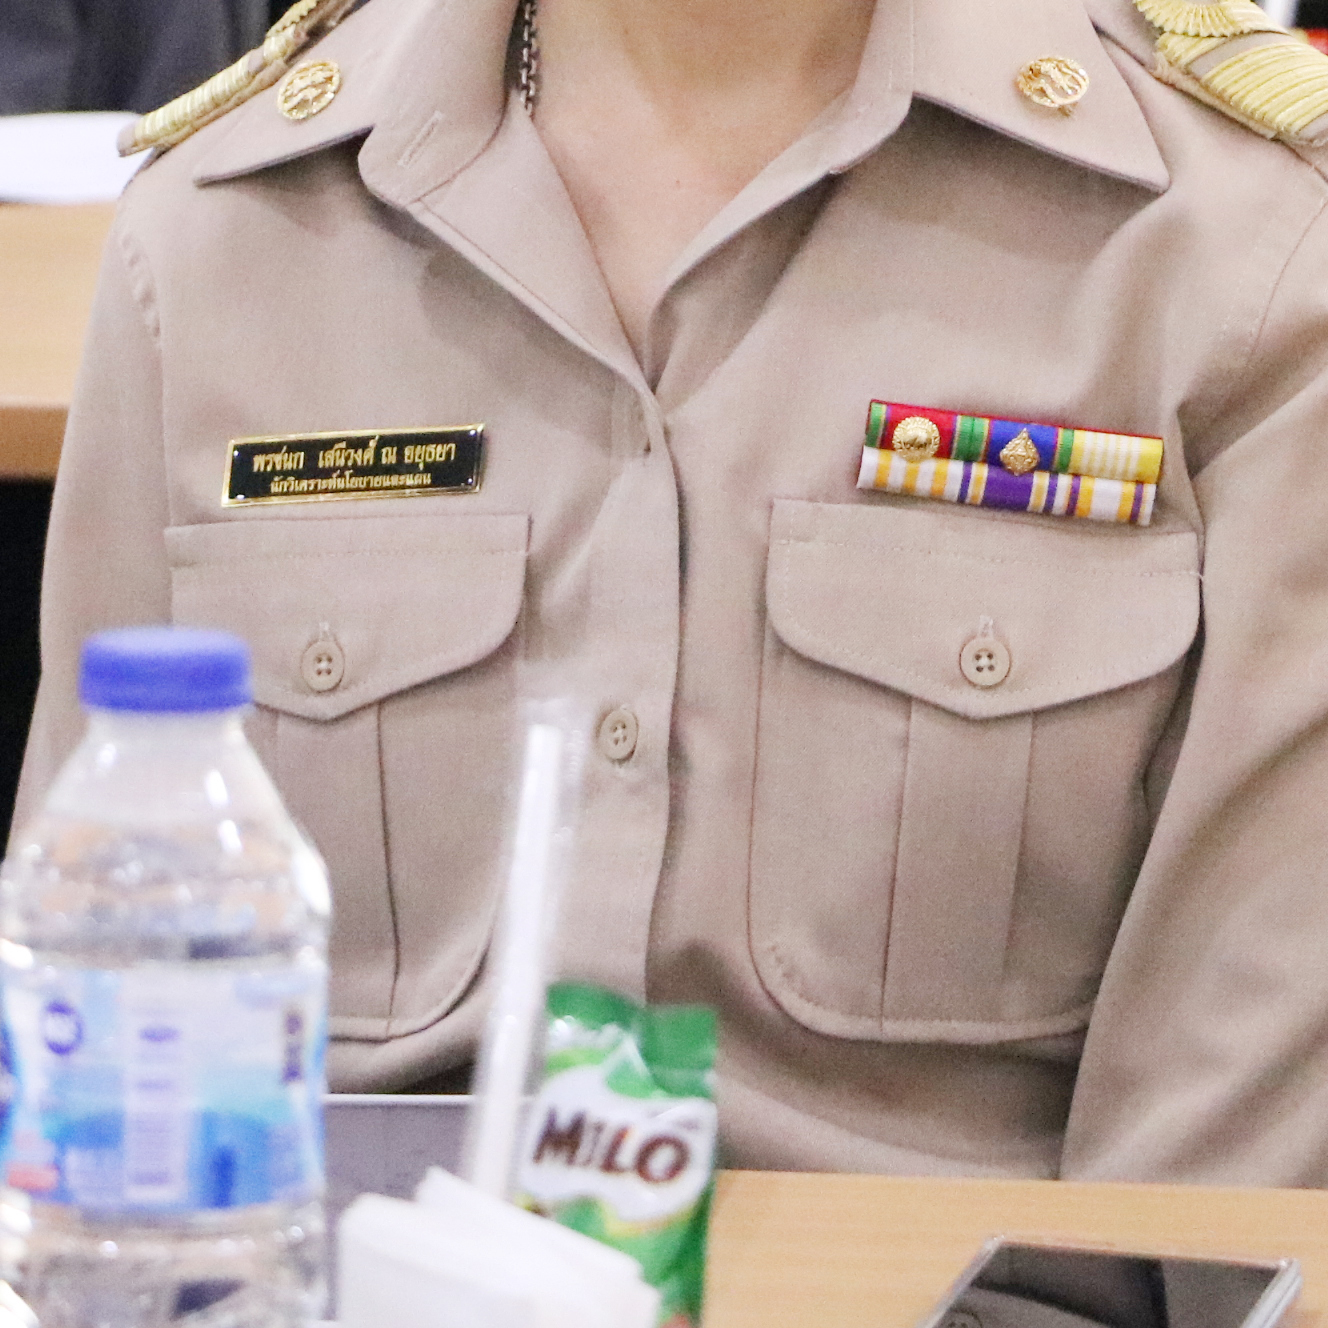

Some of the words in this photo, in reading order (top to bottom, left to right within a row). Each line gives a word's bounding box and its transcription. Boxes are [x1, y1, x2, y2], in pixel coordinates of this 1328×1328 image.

[381, 447, 397, 464] ณ
[404, 443, 456, 470] อยุธยา
[533, 1105, 690, 1184] MILO
